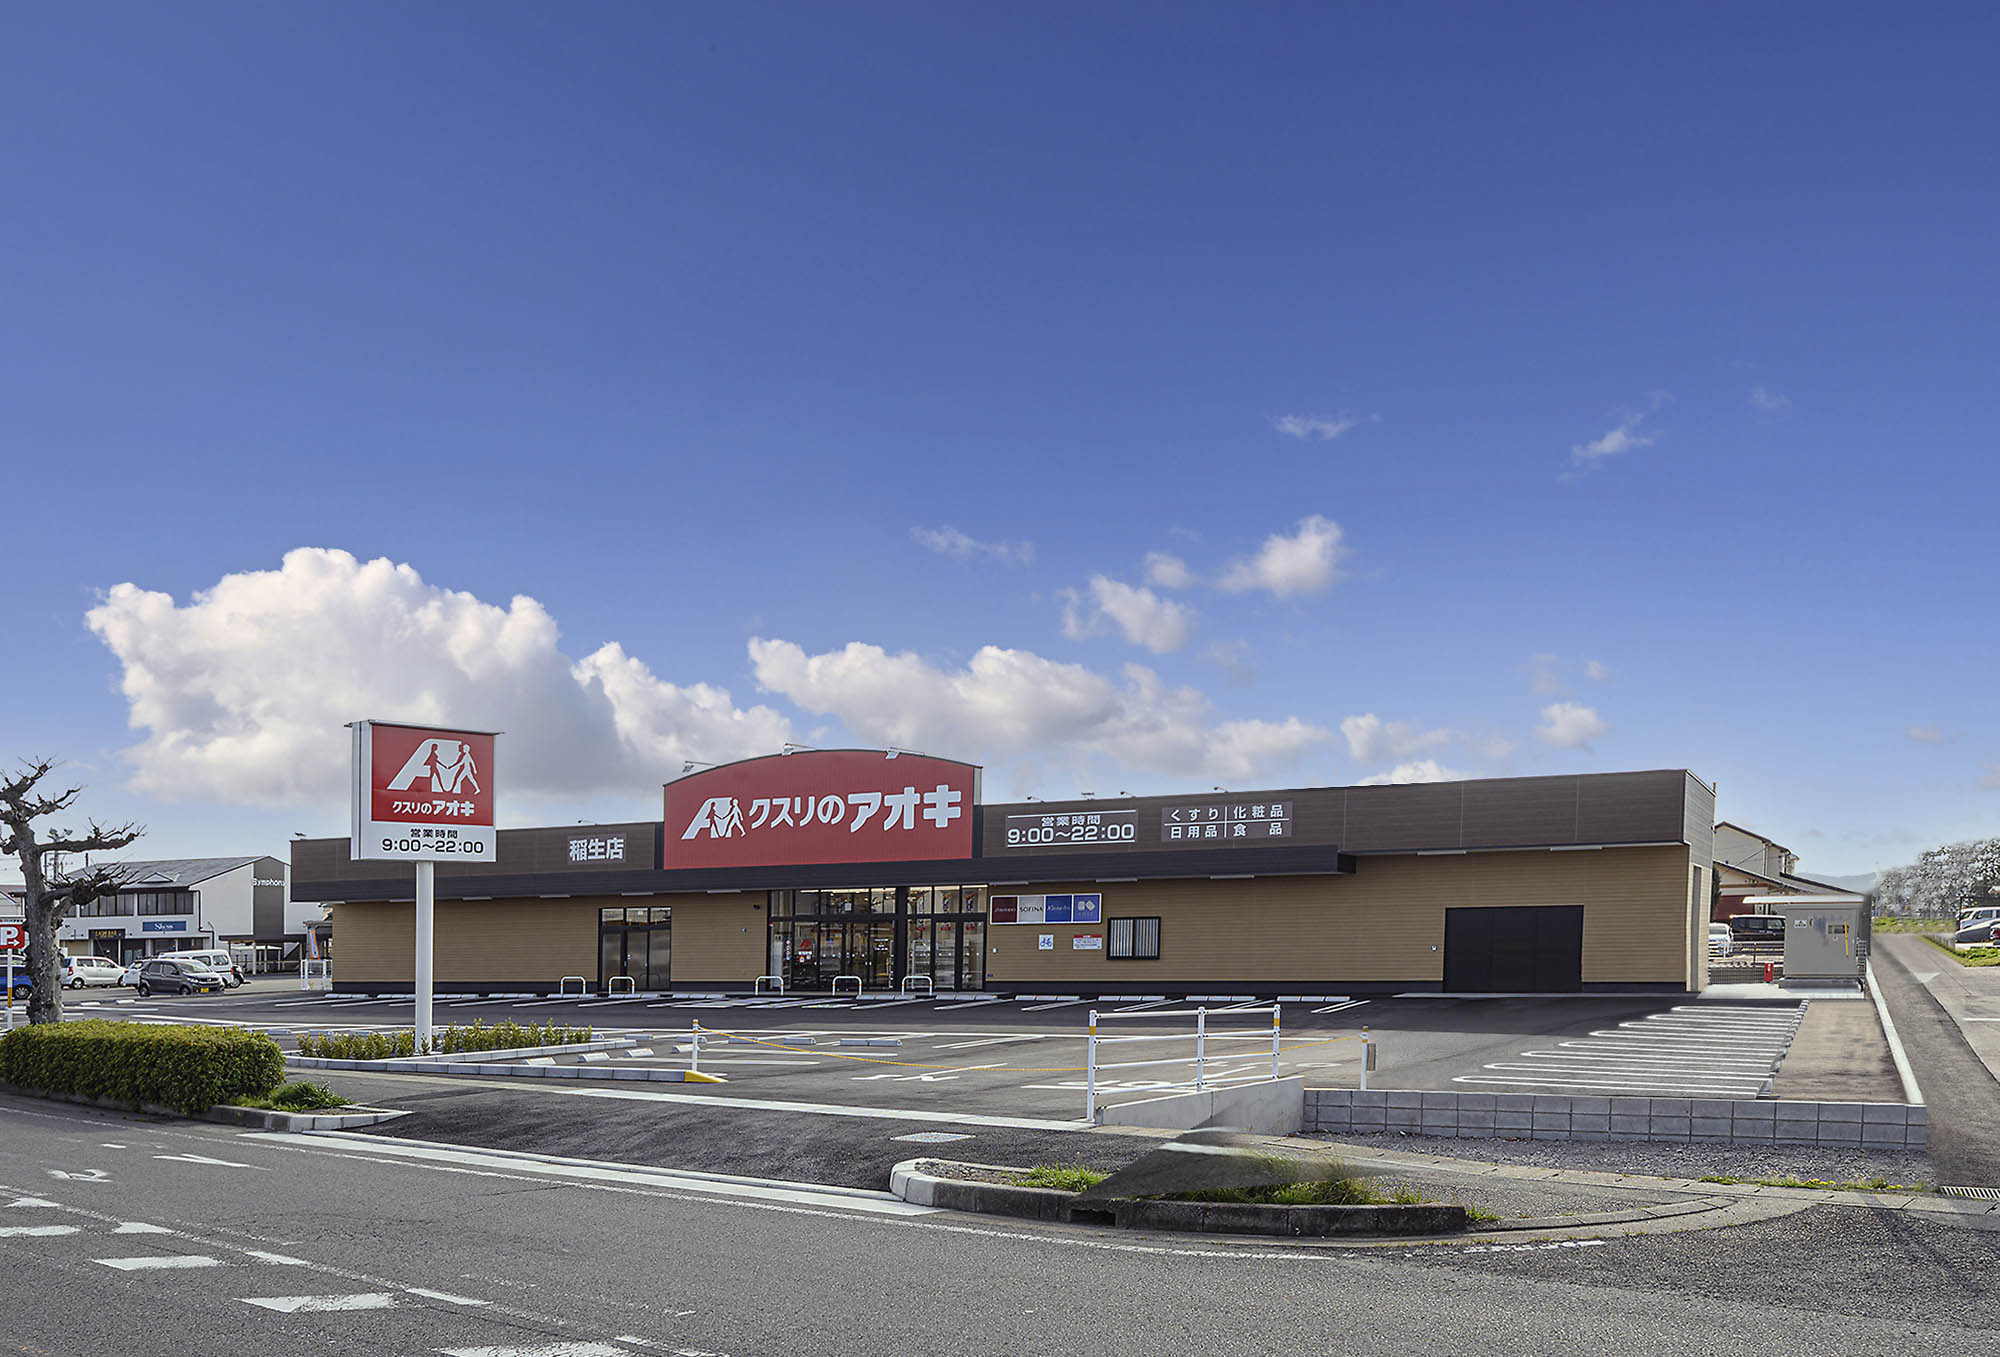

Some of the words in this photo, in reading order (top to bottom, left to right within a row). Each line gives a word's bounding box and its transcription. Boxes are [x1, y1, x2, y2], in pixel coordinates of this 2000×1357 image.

[392, 800, 475, 817] クスリのアオキ
[748, 784, 962, 833] クスリのアオキ
[1171, 808, 1219, 821] くすり
[1232, 804, 1283, 819] 化粧品
[1041, 815, 1100, 827] 営業時間
[410, 828, 458, 839] 営業時間
[1171, 825, 1217, 839] 日用品
[569, 837, 625, 861] 稲生店
[0, 926, 19, 946] P
